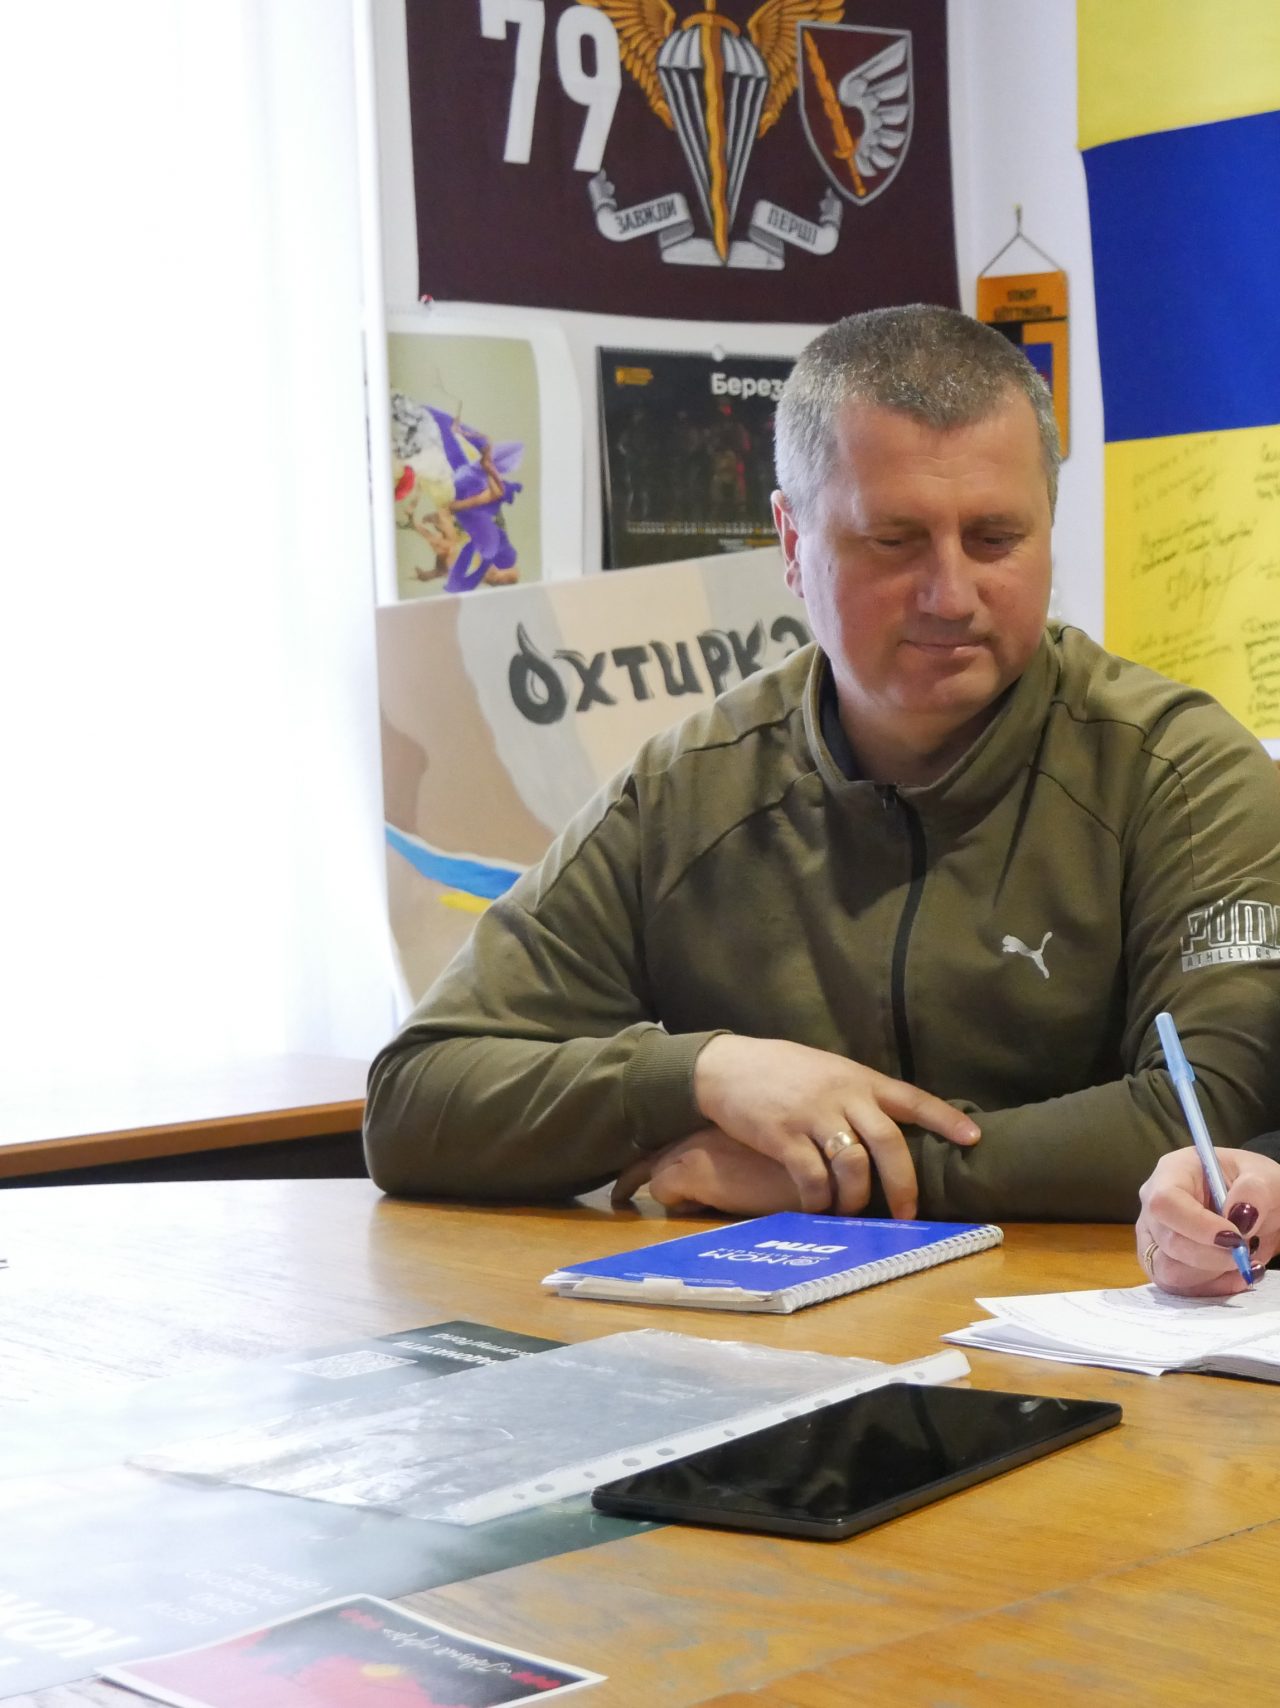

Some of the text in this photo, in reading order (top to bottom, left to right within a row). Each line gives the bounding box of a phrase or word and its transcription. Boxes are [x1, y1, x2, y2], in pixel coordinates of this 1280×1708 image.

[480, 0, 622, 172] 79
[615, 197, 818, 246] ЗАВЖДИ ПЕРШІ
[710, 371, 785, 400] Берез
[1187, 946, 1272, 968] ATHLETICS
[754, 1239, 849, 1254] DTM
